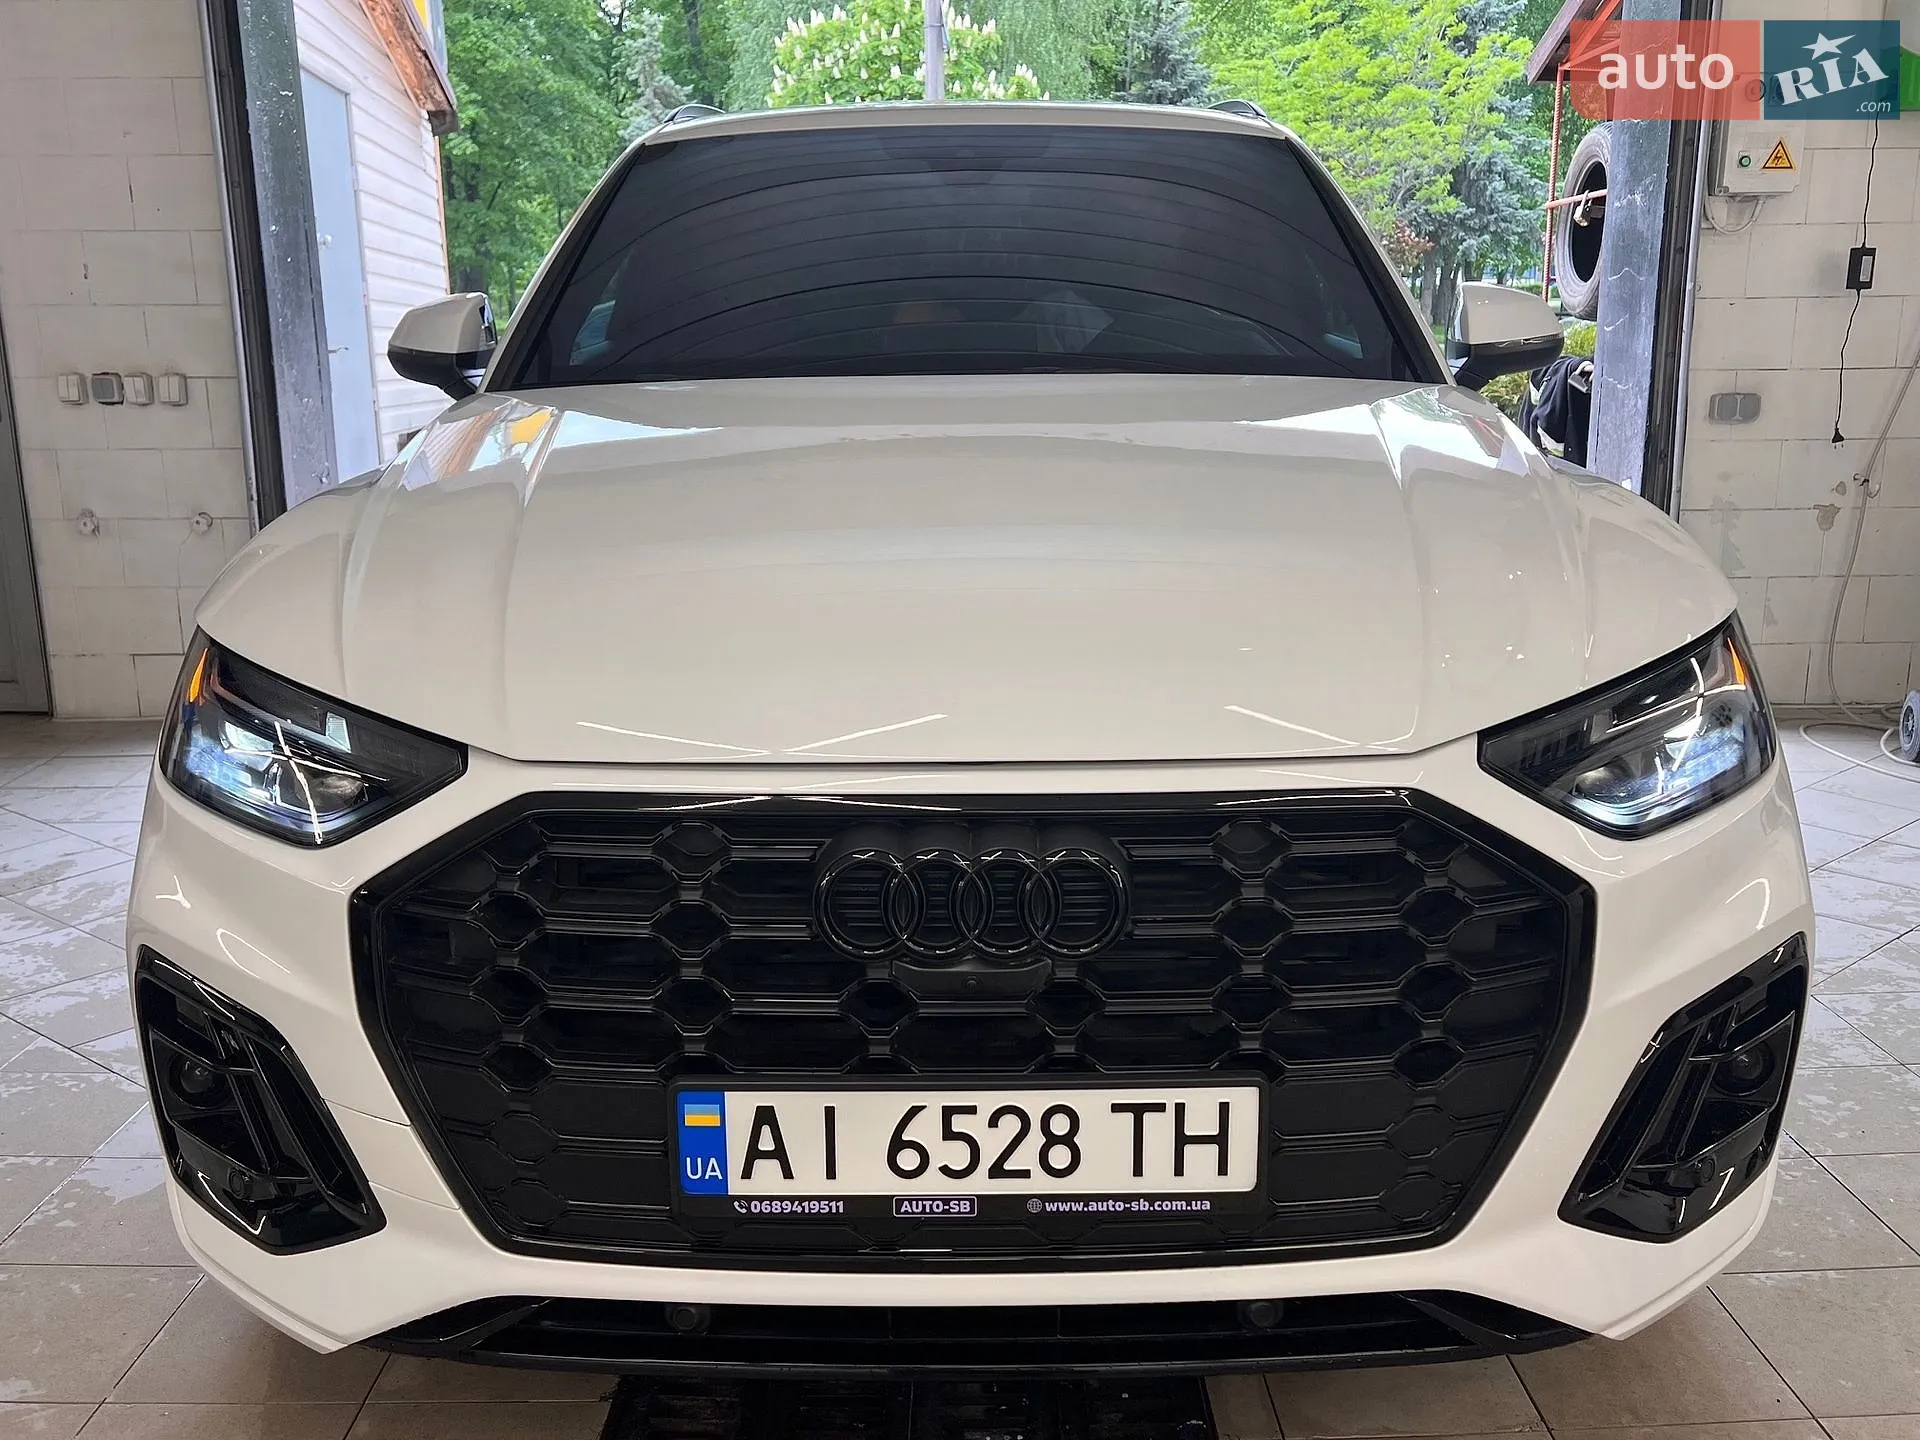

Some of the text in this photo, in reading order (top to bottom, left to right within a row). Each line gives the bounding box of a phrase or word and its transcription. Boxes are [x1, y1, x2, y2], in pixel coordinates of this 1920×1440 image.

[886, 1104, 1082, 1181] 6528
[1111, 1101, 1230, 1178] TH
[686, 1157, 723, 1180] UA
[750, 1200, 844, 1214] 0689419511
[900, 1200, 971, 1213] AUTO-SB
[1045, 1198, 1211, 1213] www.auto-sb.com.ua
